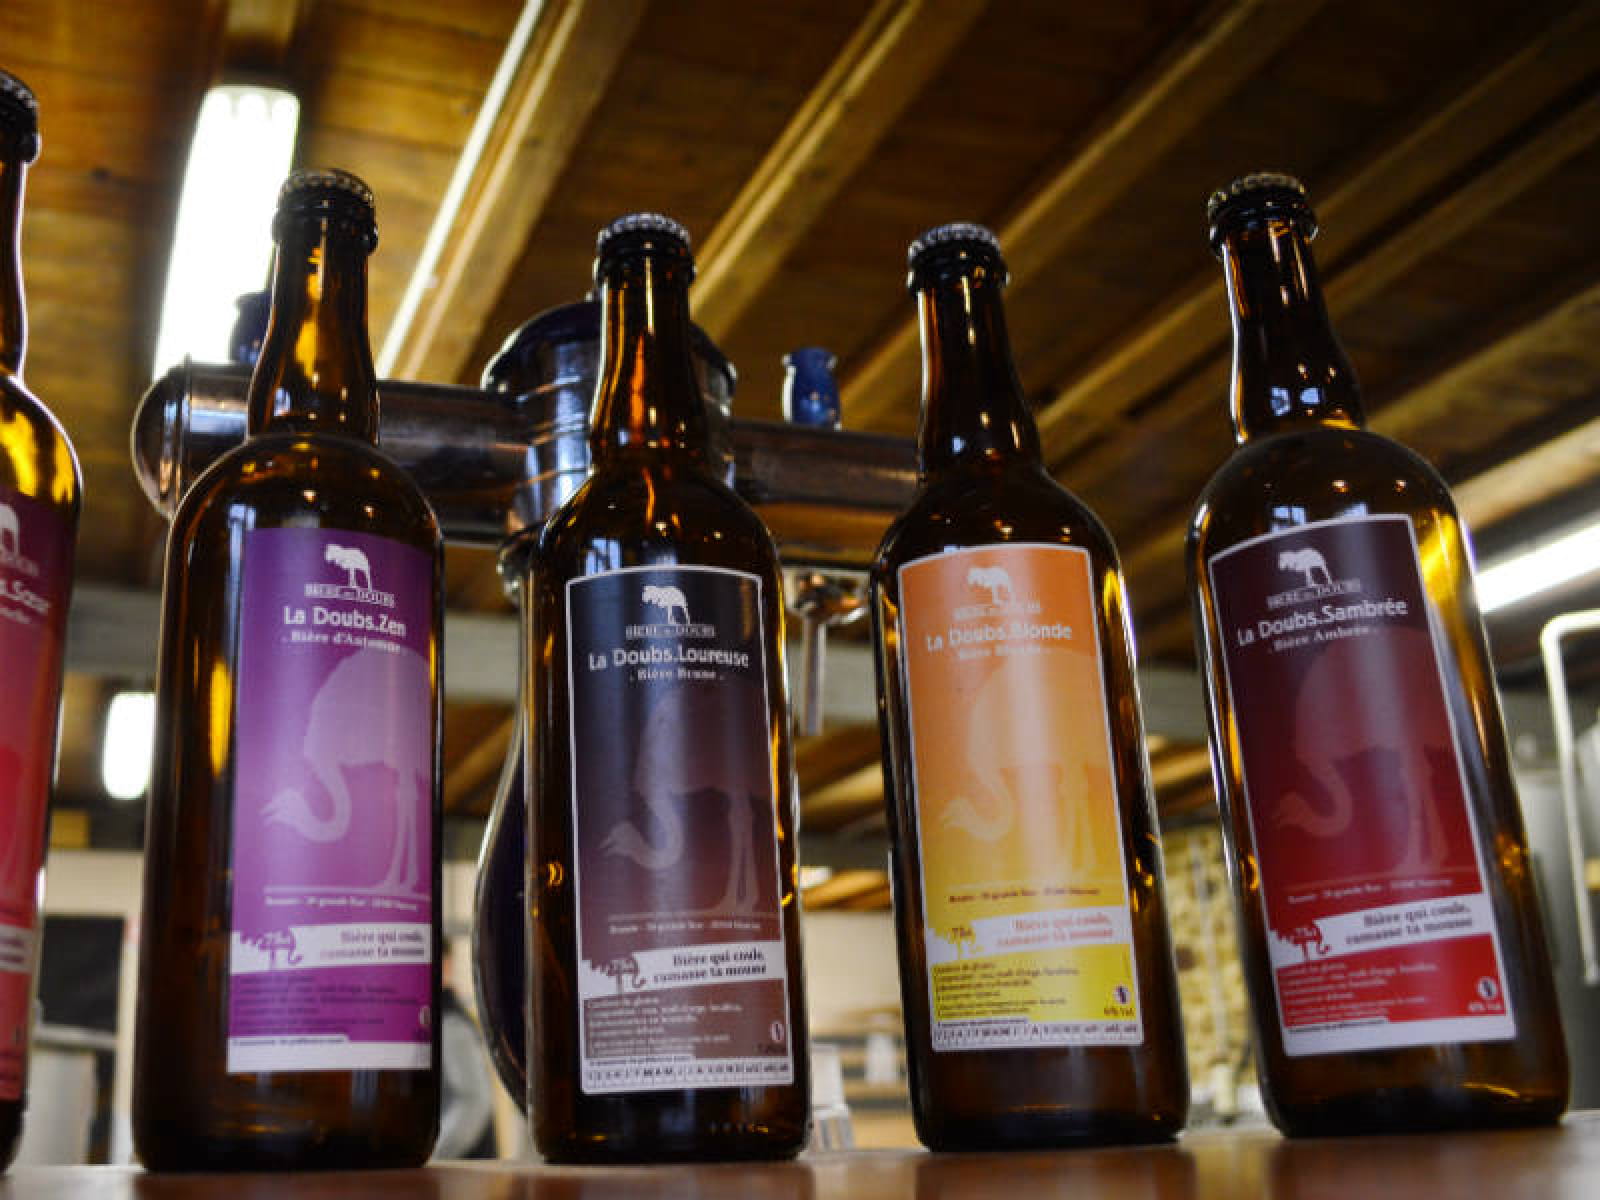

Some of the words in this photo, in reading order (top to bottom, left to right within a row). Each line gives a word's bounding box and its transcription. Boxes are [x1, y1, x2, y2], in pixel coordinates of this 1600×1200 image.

[283, 606, 305, 625] La
[312, 606, 408, 637] Doubs.Zen
[1237, 627, 1254, 646] La
[1258, 598, 1409, 639] Doubs.Sambrée
[927, 634, 943, 652] La
[949, 620, 1073, 646] Doubs.Blonde
[589, 652, 607, 671] La
[613, 645, 749, 669] Doubs.Loureuse
[1404, 906, 1428, 923] qui
[710, 951, 730, 966] qui
